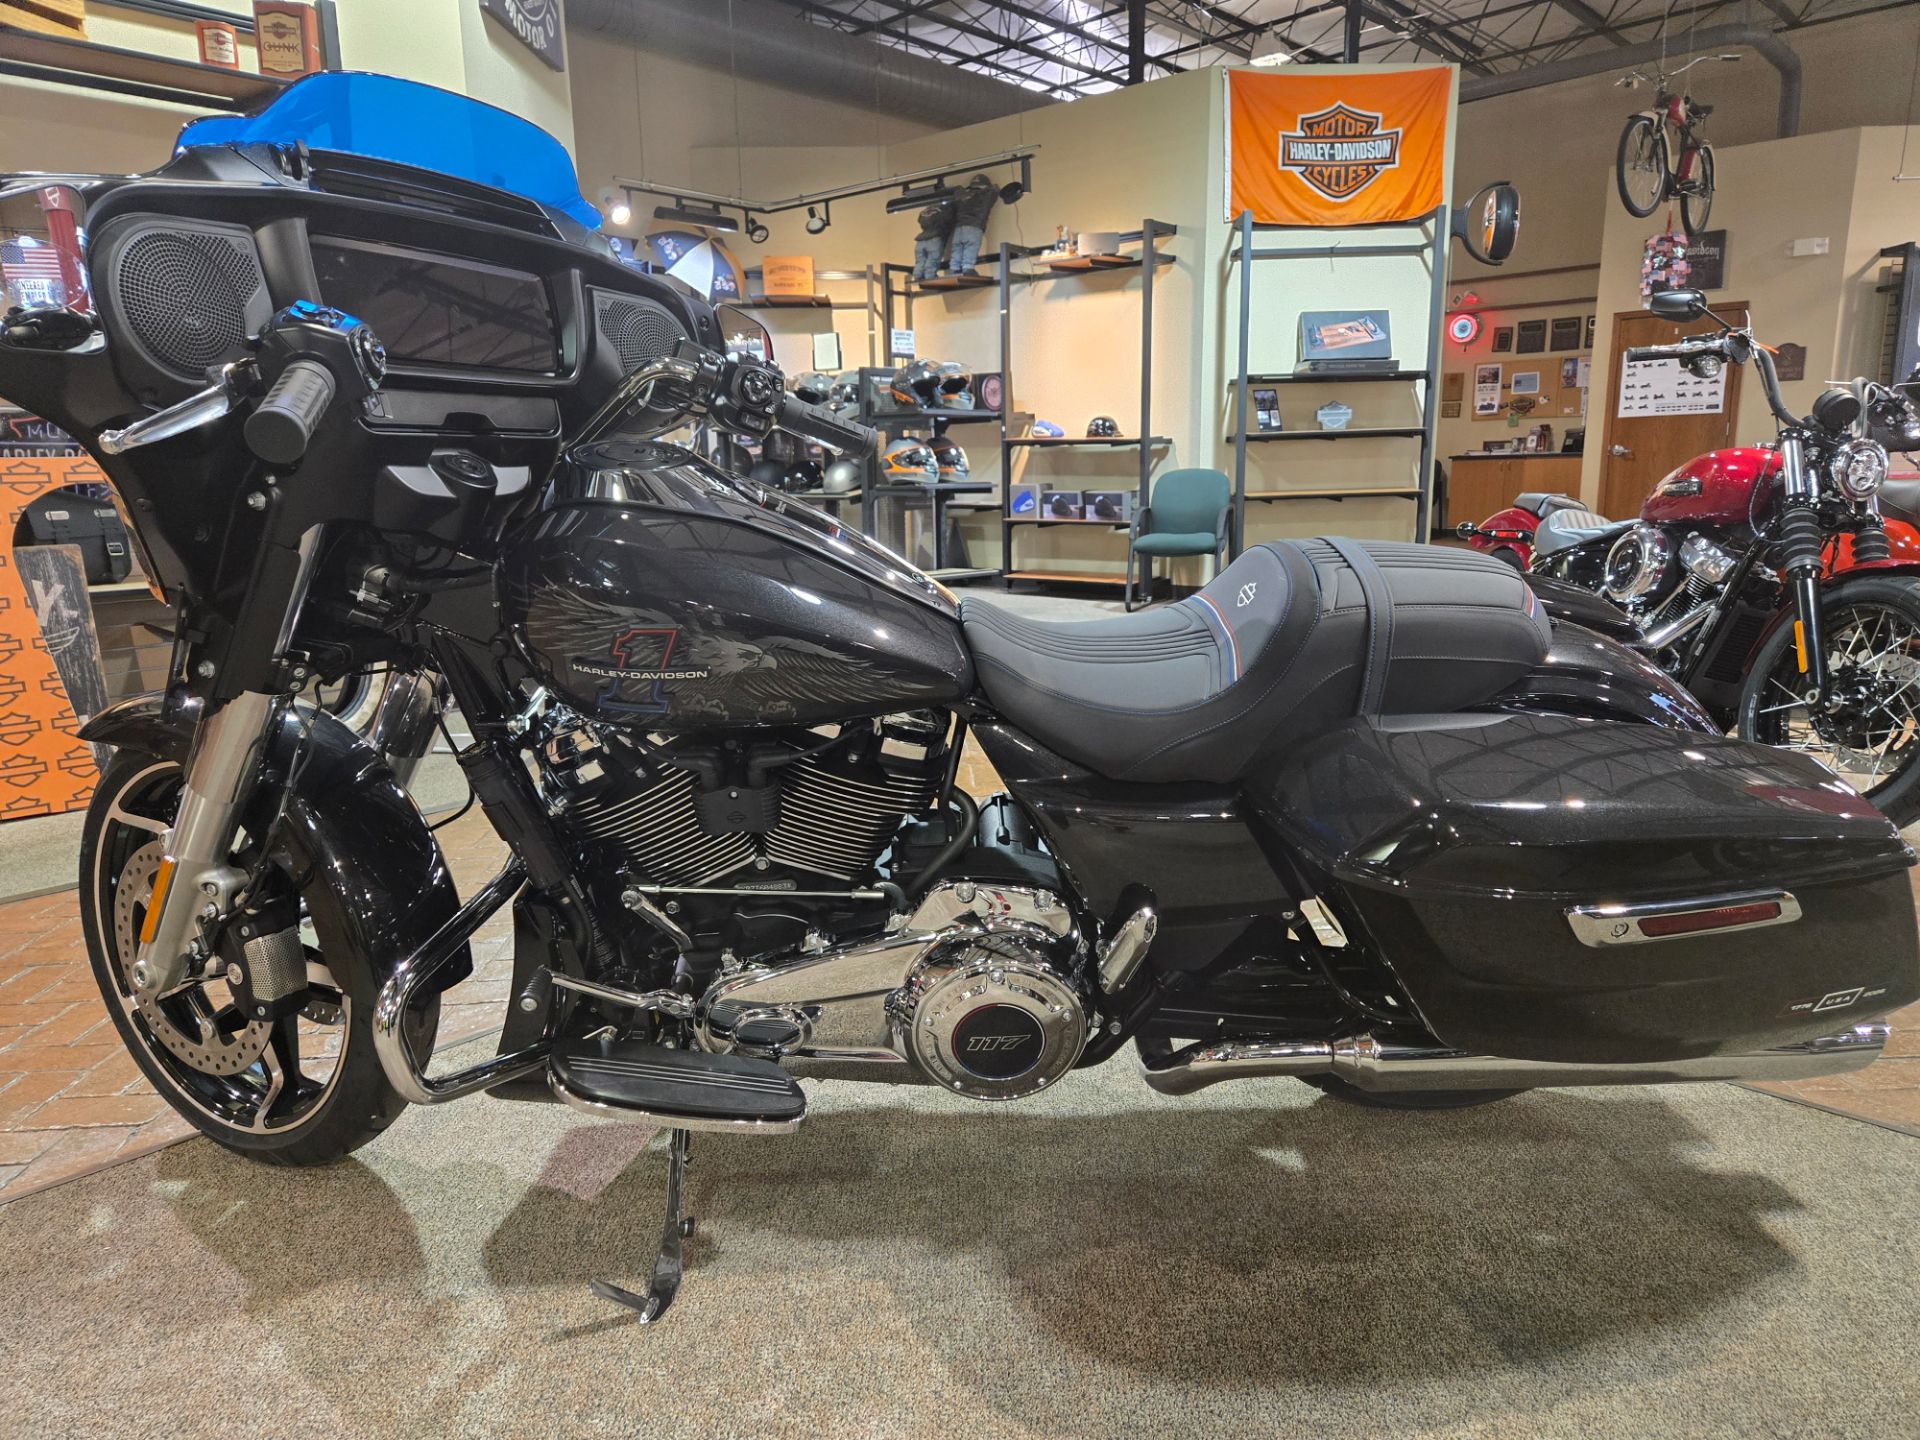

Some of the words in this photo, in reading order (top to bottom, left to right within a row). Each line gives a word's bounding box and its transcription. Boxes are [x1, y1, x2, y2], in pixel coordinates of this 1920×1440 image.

[263, 41, 301, 55] GUNK
[1312, 114, 1367, 137] MOTOR
[1289, 138, 1393, 161] HARLEY-DAVIDSON
[1313, 166, 1367, 192] CYCLES
[572, 663, 708, 680] HARLEY-DAVIDSON
[966, 1034, 1031, 1051] 117
